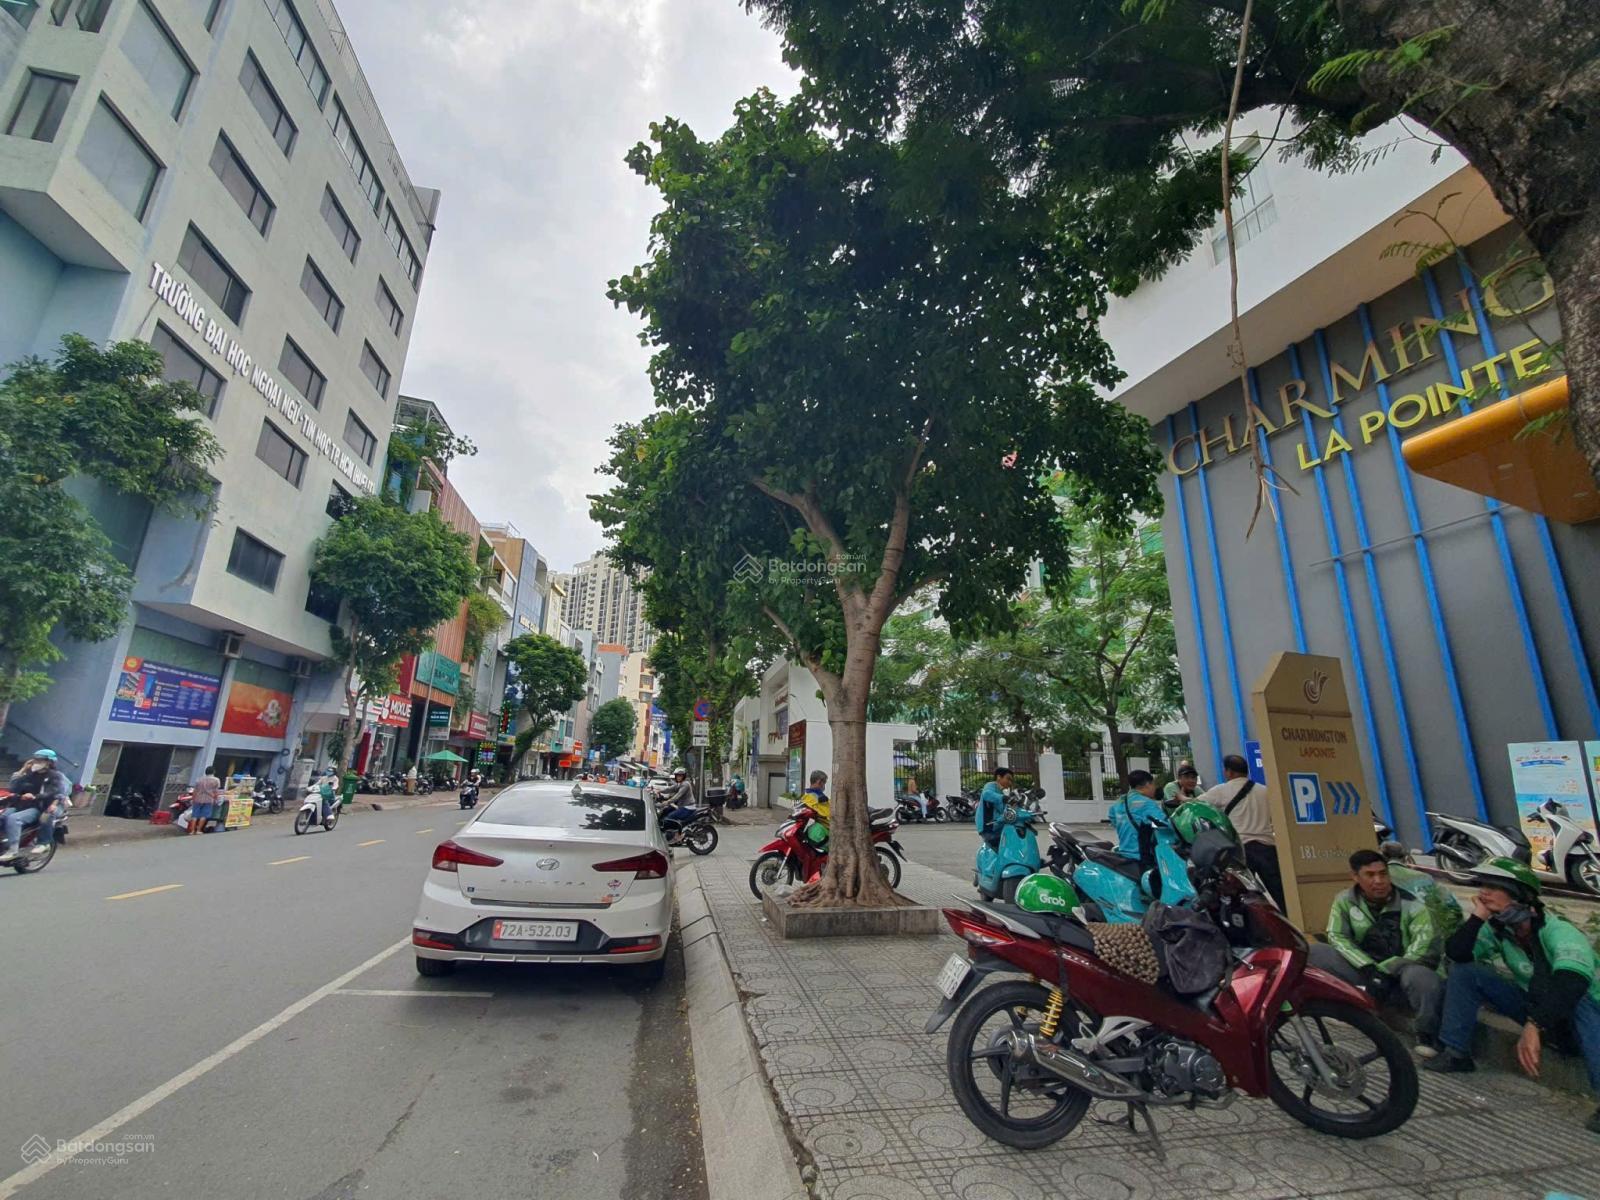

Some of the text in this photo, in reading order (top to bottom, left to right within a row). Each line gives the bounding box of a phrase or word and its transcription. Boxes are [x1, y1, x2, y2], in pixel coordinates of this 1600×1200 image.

[150, 261, 206, 333] TRƯỜNG
[205, 317, 228, 355] ĐẠI
[226, 339, 251, 377] HỌC
[251, 364, 283, 408] NGOẠI
[281, 392, 303, 425] NGỮ
[1297, 337, 1552, 471] LA POINTE
[391, 699, 412, 718] MIXUE
[1281, 727, 1348, 743] CHARMINGTON
[1293, 778, 1317, 818] P
[1300, 845, 1317, 859] 181
[1039, 892, 1066, 907] Grab
